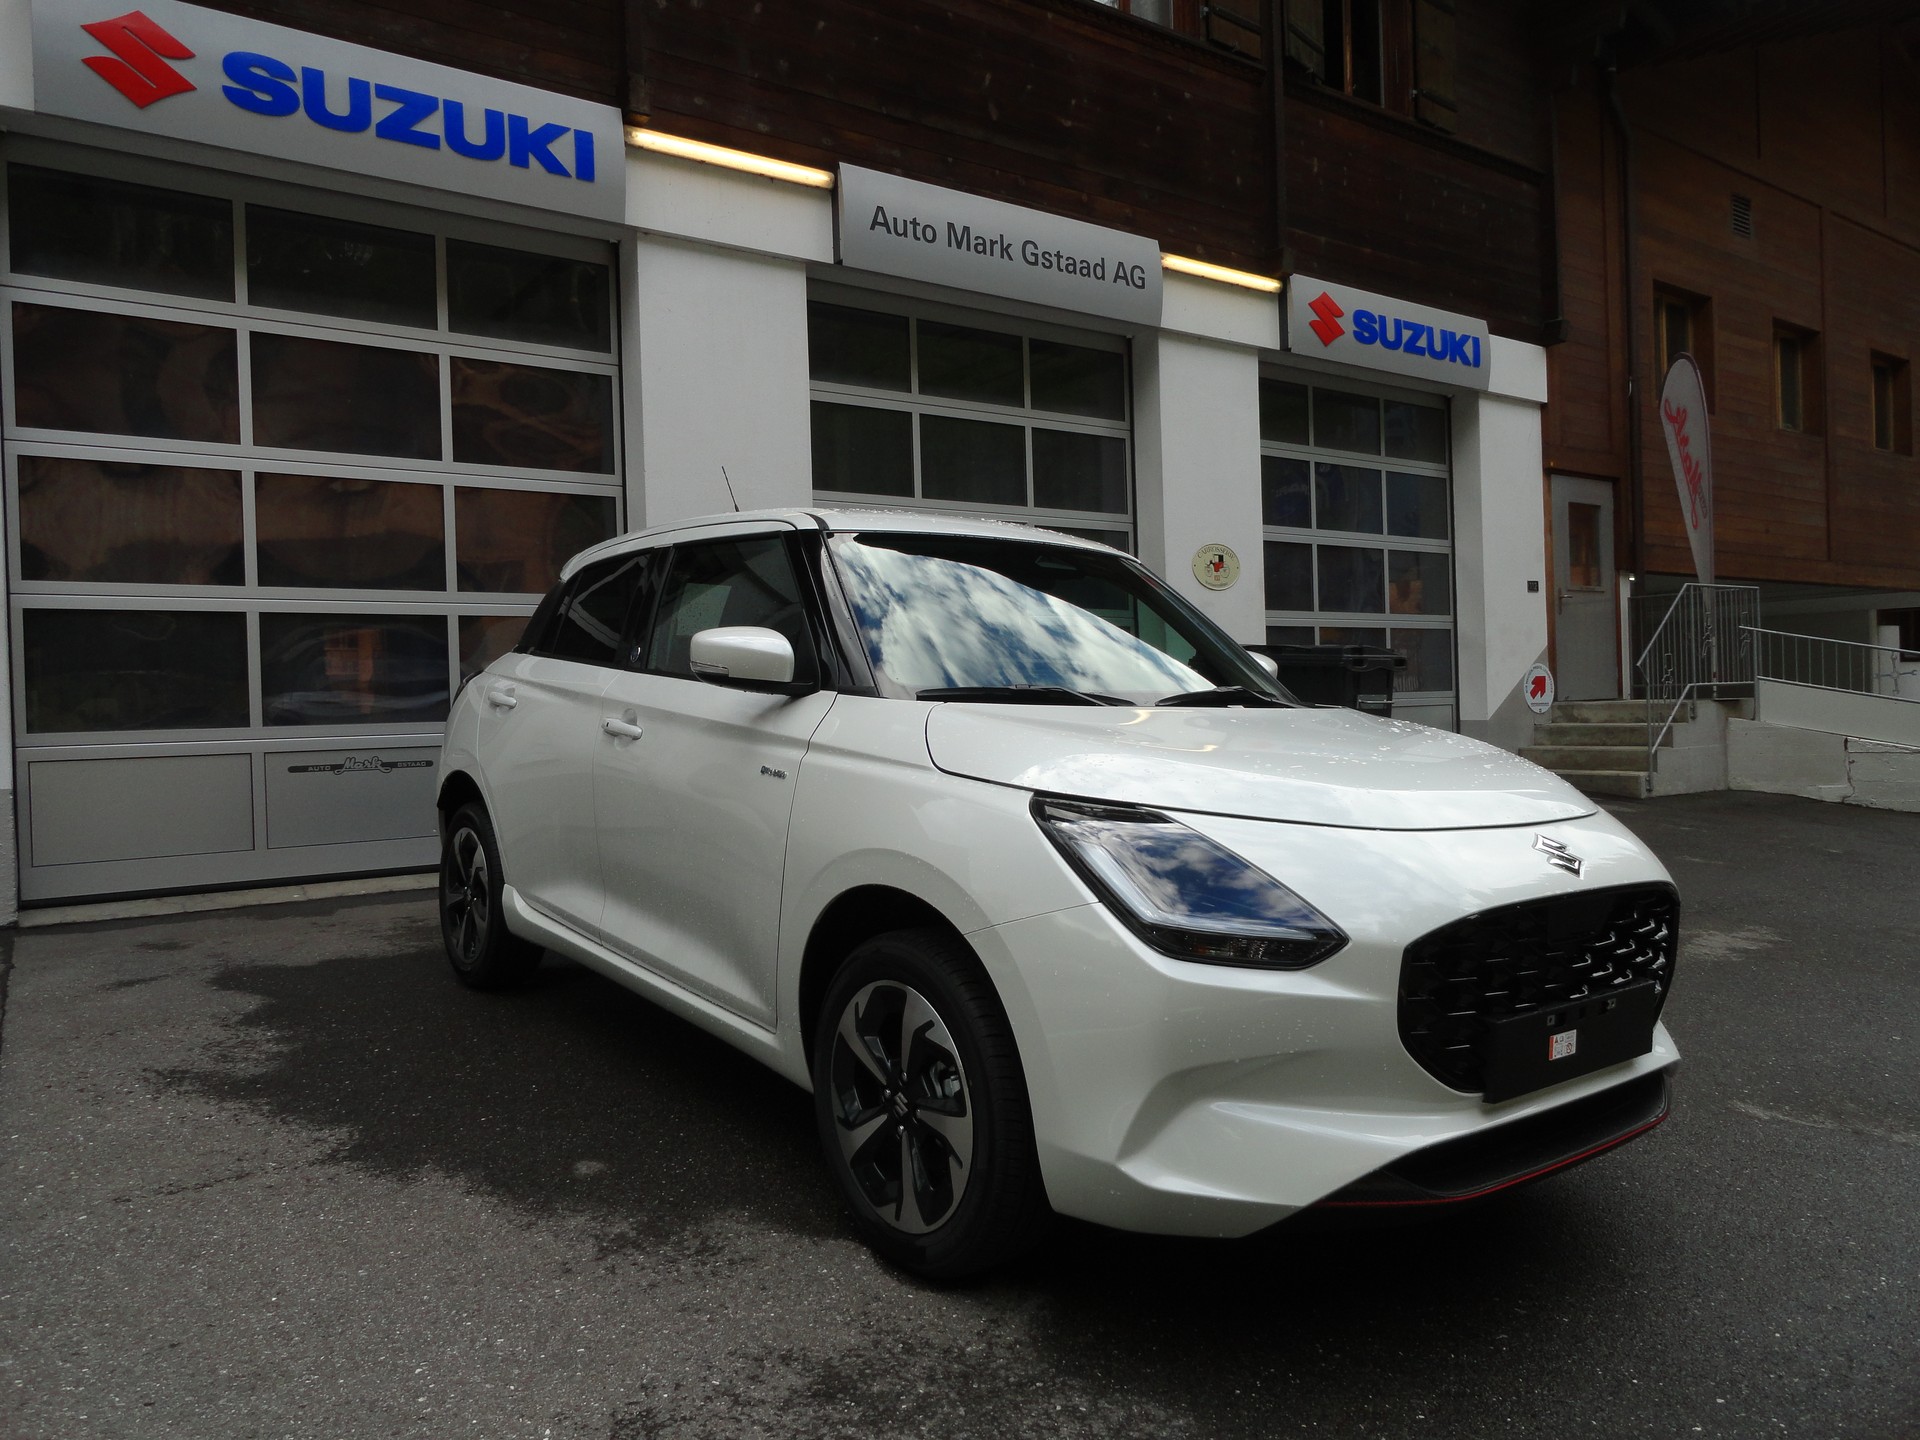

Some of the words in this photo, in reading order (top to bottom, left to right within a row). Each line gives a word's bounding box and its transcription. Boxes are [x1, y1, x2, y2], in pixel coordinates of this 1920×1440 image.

[221, 51, 595, 182] SUZUKI
[869, 205, 937, 244] Auto
[947, 221, 1014, 262] Mark
[1021, 240, 1106, 281] Gstaad
[1113, 262, 1147, 289] AG
[1353, 309, 1481, 368] SUZUKI
[334, 756, 392, 775] Mark
